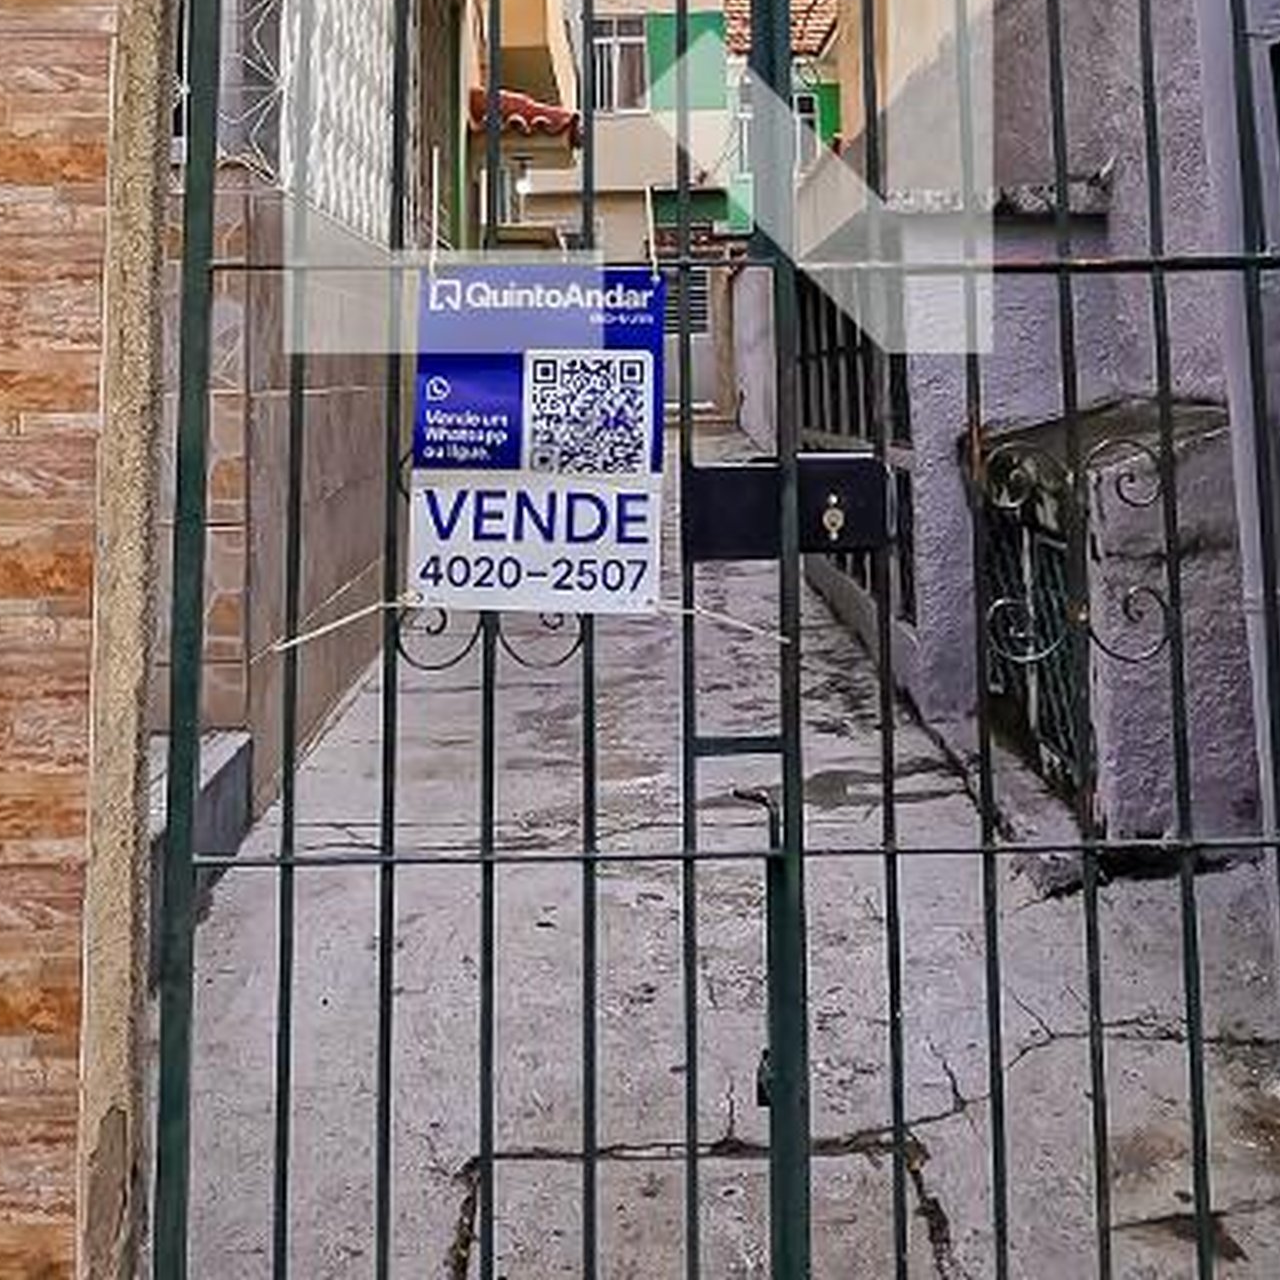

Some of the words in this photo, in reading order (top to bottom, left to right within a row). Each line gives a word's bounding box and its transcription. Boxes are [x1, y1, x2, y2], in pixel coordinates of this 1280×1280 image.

[466, 281, 655, 310] QuintoAndar
[424, 488, 650, 545] VENDE
[419, 554, 649, 593] 4020-2507
